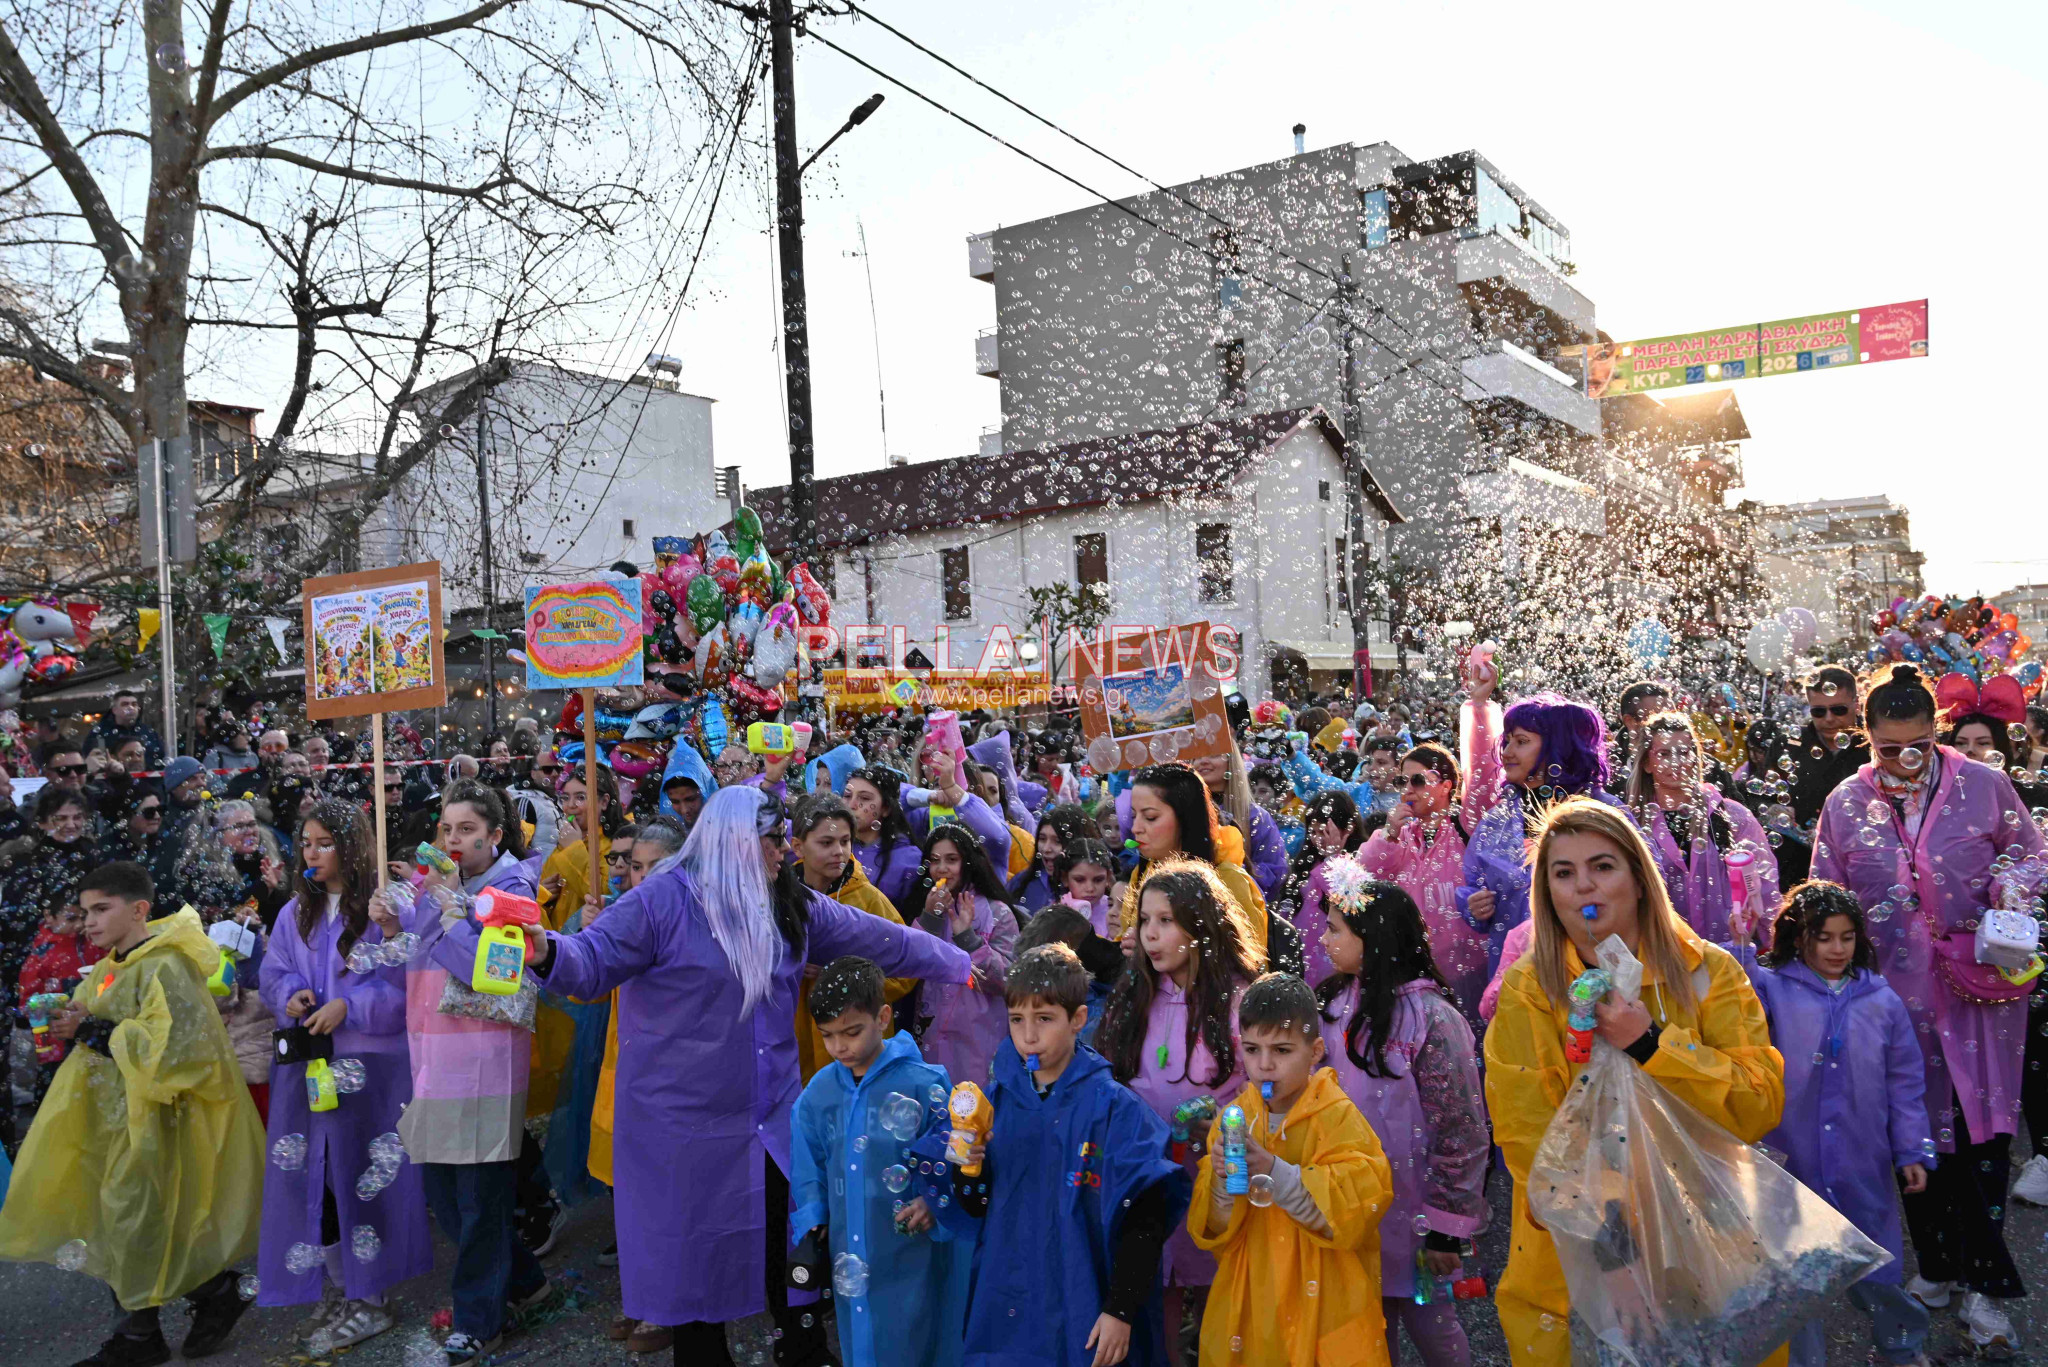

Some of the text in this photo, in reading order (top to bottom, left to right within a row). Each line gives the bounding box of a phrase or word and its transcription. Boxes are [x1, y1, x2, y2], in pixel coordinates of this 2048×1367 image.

[1633, 337, 1704, 358] ΜΕΓΑΛΗ
[1709, 316, 1847, 348] ΚΑΡΝΑΒΑΛΙΚΗ
[1633, 332, 1848, 372] ΠΑΡΕΛΑΣΗ ΣΤΗ ΣΚΥΔΡΑ
